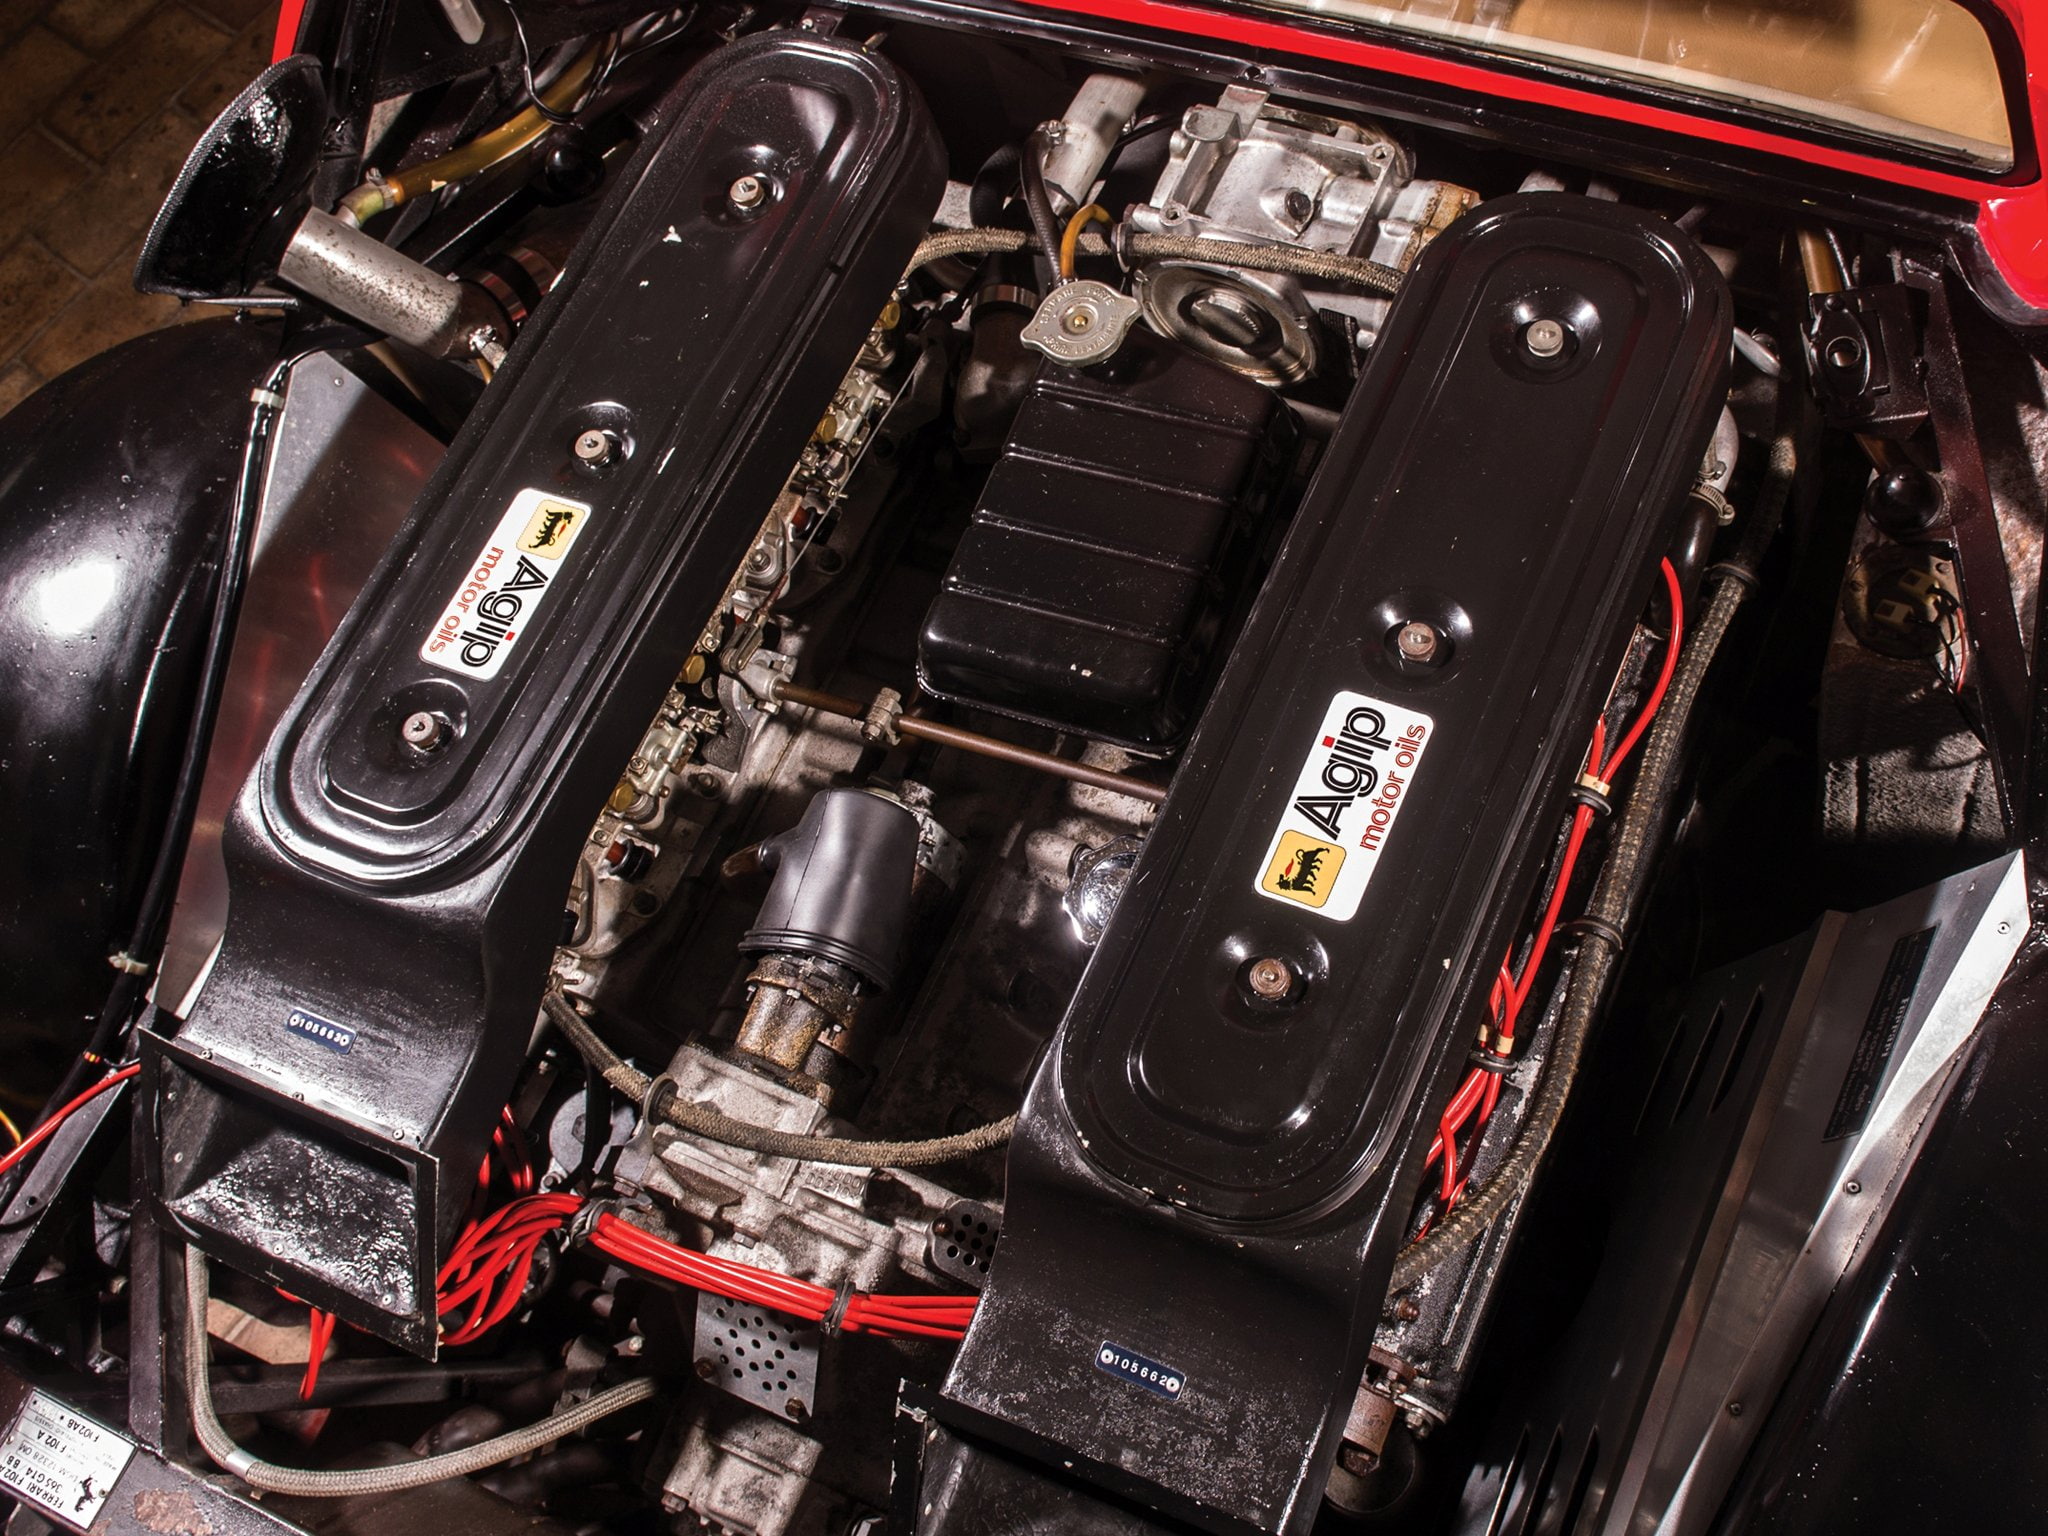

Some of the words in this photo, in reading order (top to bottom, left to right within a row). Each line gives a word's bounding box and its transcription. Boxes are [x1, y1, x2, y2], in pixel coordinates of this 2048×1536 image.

[457, 546, 505, 613] motor
[459, 555, 549, 668] Agip
[429, 615, 461, 653] oils
[1293, 706, 1392, 841] Agip
[1360, 770, 1406, 851] motor
[1395, 724, 1427, 768] oils
[1113, 1354, 1168, 1386] 105662
[26, 1482, 64, 1508] FERRARI
